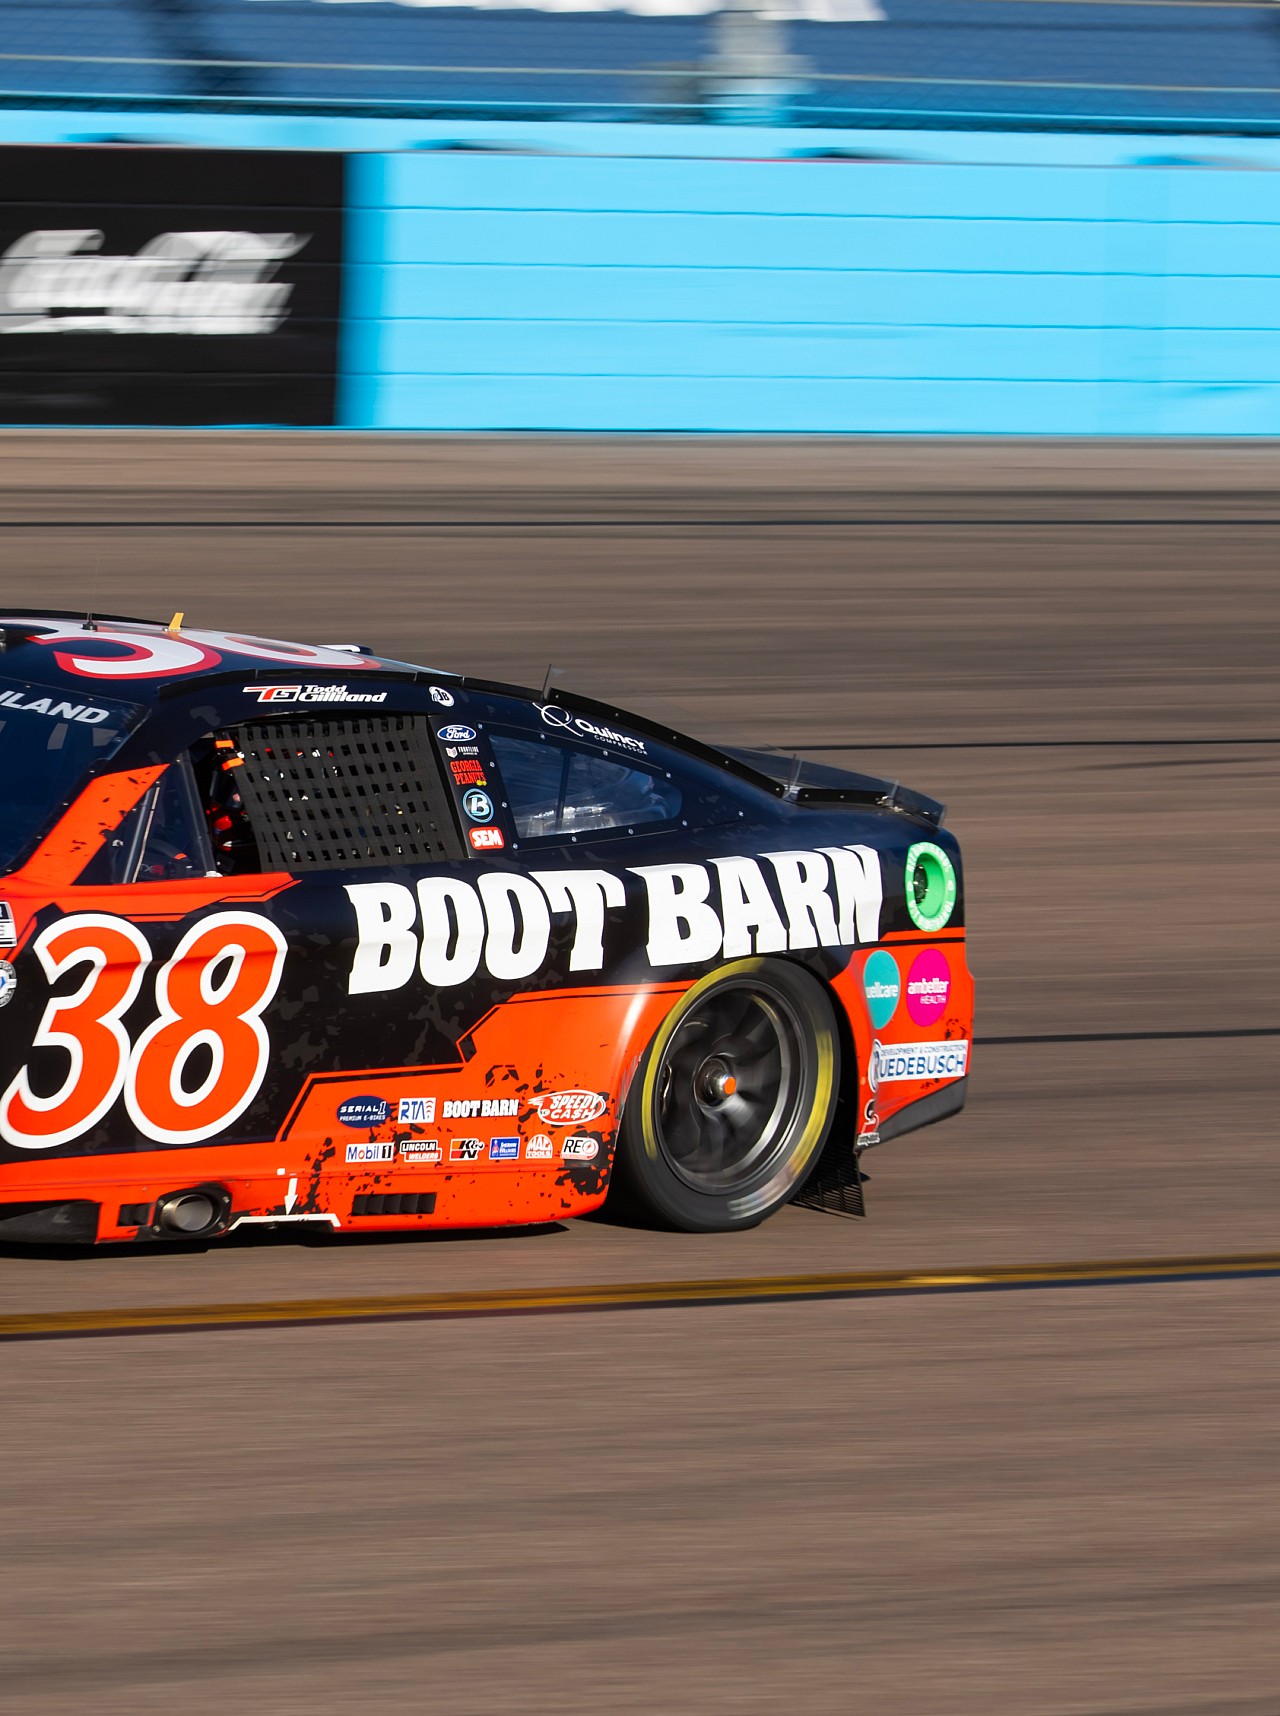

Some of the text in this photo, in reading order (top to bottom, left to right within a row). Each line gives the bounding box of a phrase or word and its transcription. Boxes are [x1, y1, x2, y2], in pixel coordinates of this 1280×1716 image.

[303, 684, 348, 693] Todd
[298, 691, 388, 703] Gilliland
[574, 718, 645, 750] Quincy
[593, 734, 649, 756] COMPRESSOR
[450, 760, 483, 773] GEORGIA
[453, 772, 487, 786] PEANUTS
[471, 829, 503, 847] SEM
[342, 869, 627, 996] BOOT
[625, 844, 884, 967] BARN
[907, 977, 950, 995] ambetter
[442, 1098, 519, 1118] BOOT BARN
[549, 1094, 604, 1110] SPEEDY
[339, 1114, 362, 1122] PREMIUM
[400, 1100, 426, 1121] RTA
[347, 1145, 392, 1161] Mobil 1
[401, 1142, 436, 1152] LINCOLN
[408, 1151, 439, 1161] WELDERS
